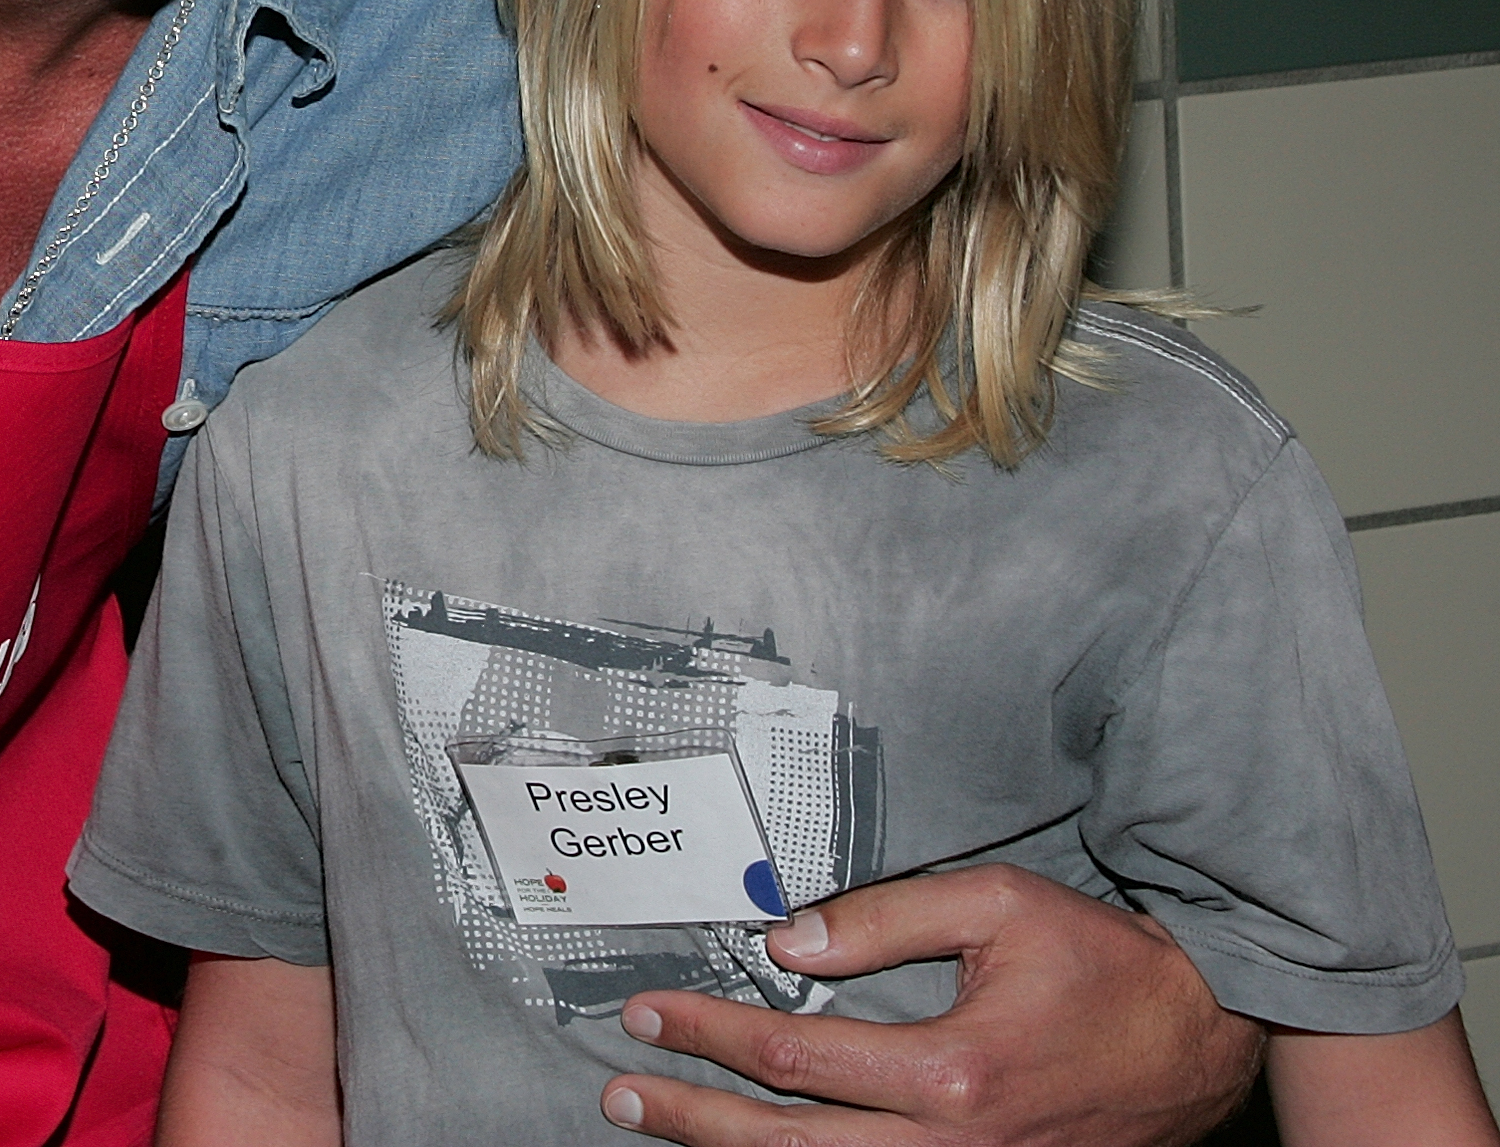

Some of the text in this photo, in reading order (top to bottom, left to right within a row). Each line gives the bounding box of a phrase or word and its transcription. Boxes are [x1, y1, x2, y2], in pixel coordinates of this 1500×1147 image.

[525, 781, 670, 815] Presley
[550, 827, 684, 858] Gerber
[514, 878, 544, 887] HOPE
[519, 894, 567, 903] HOLIDAY
